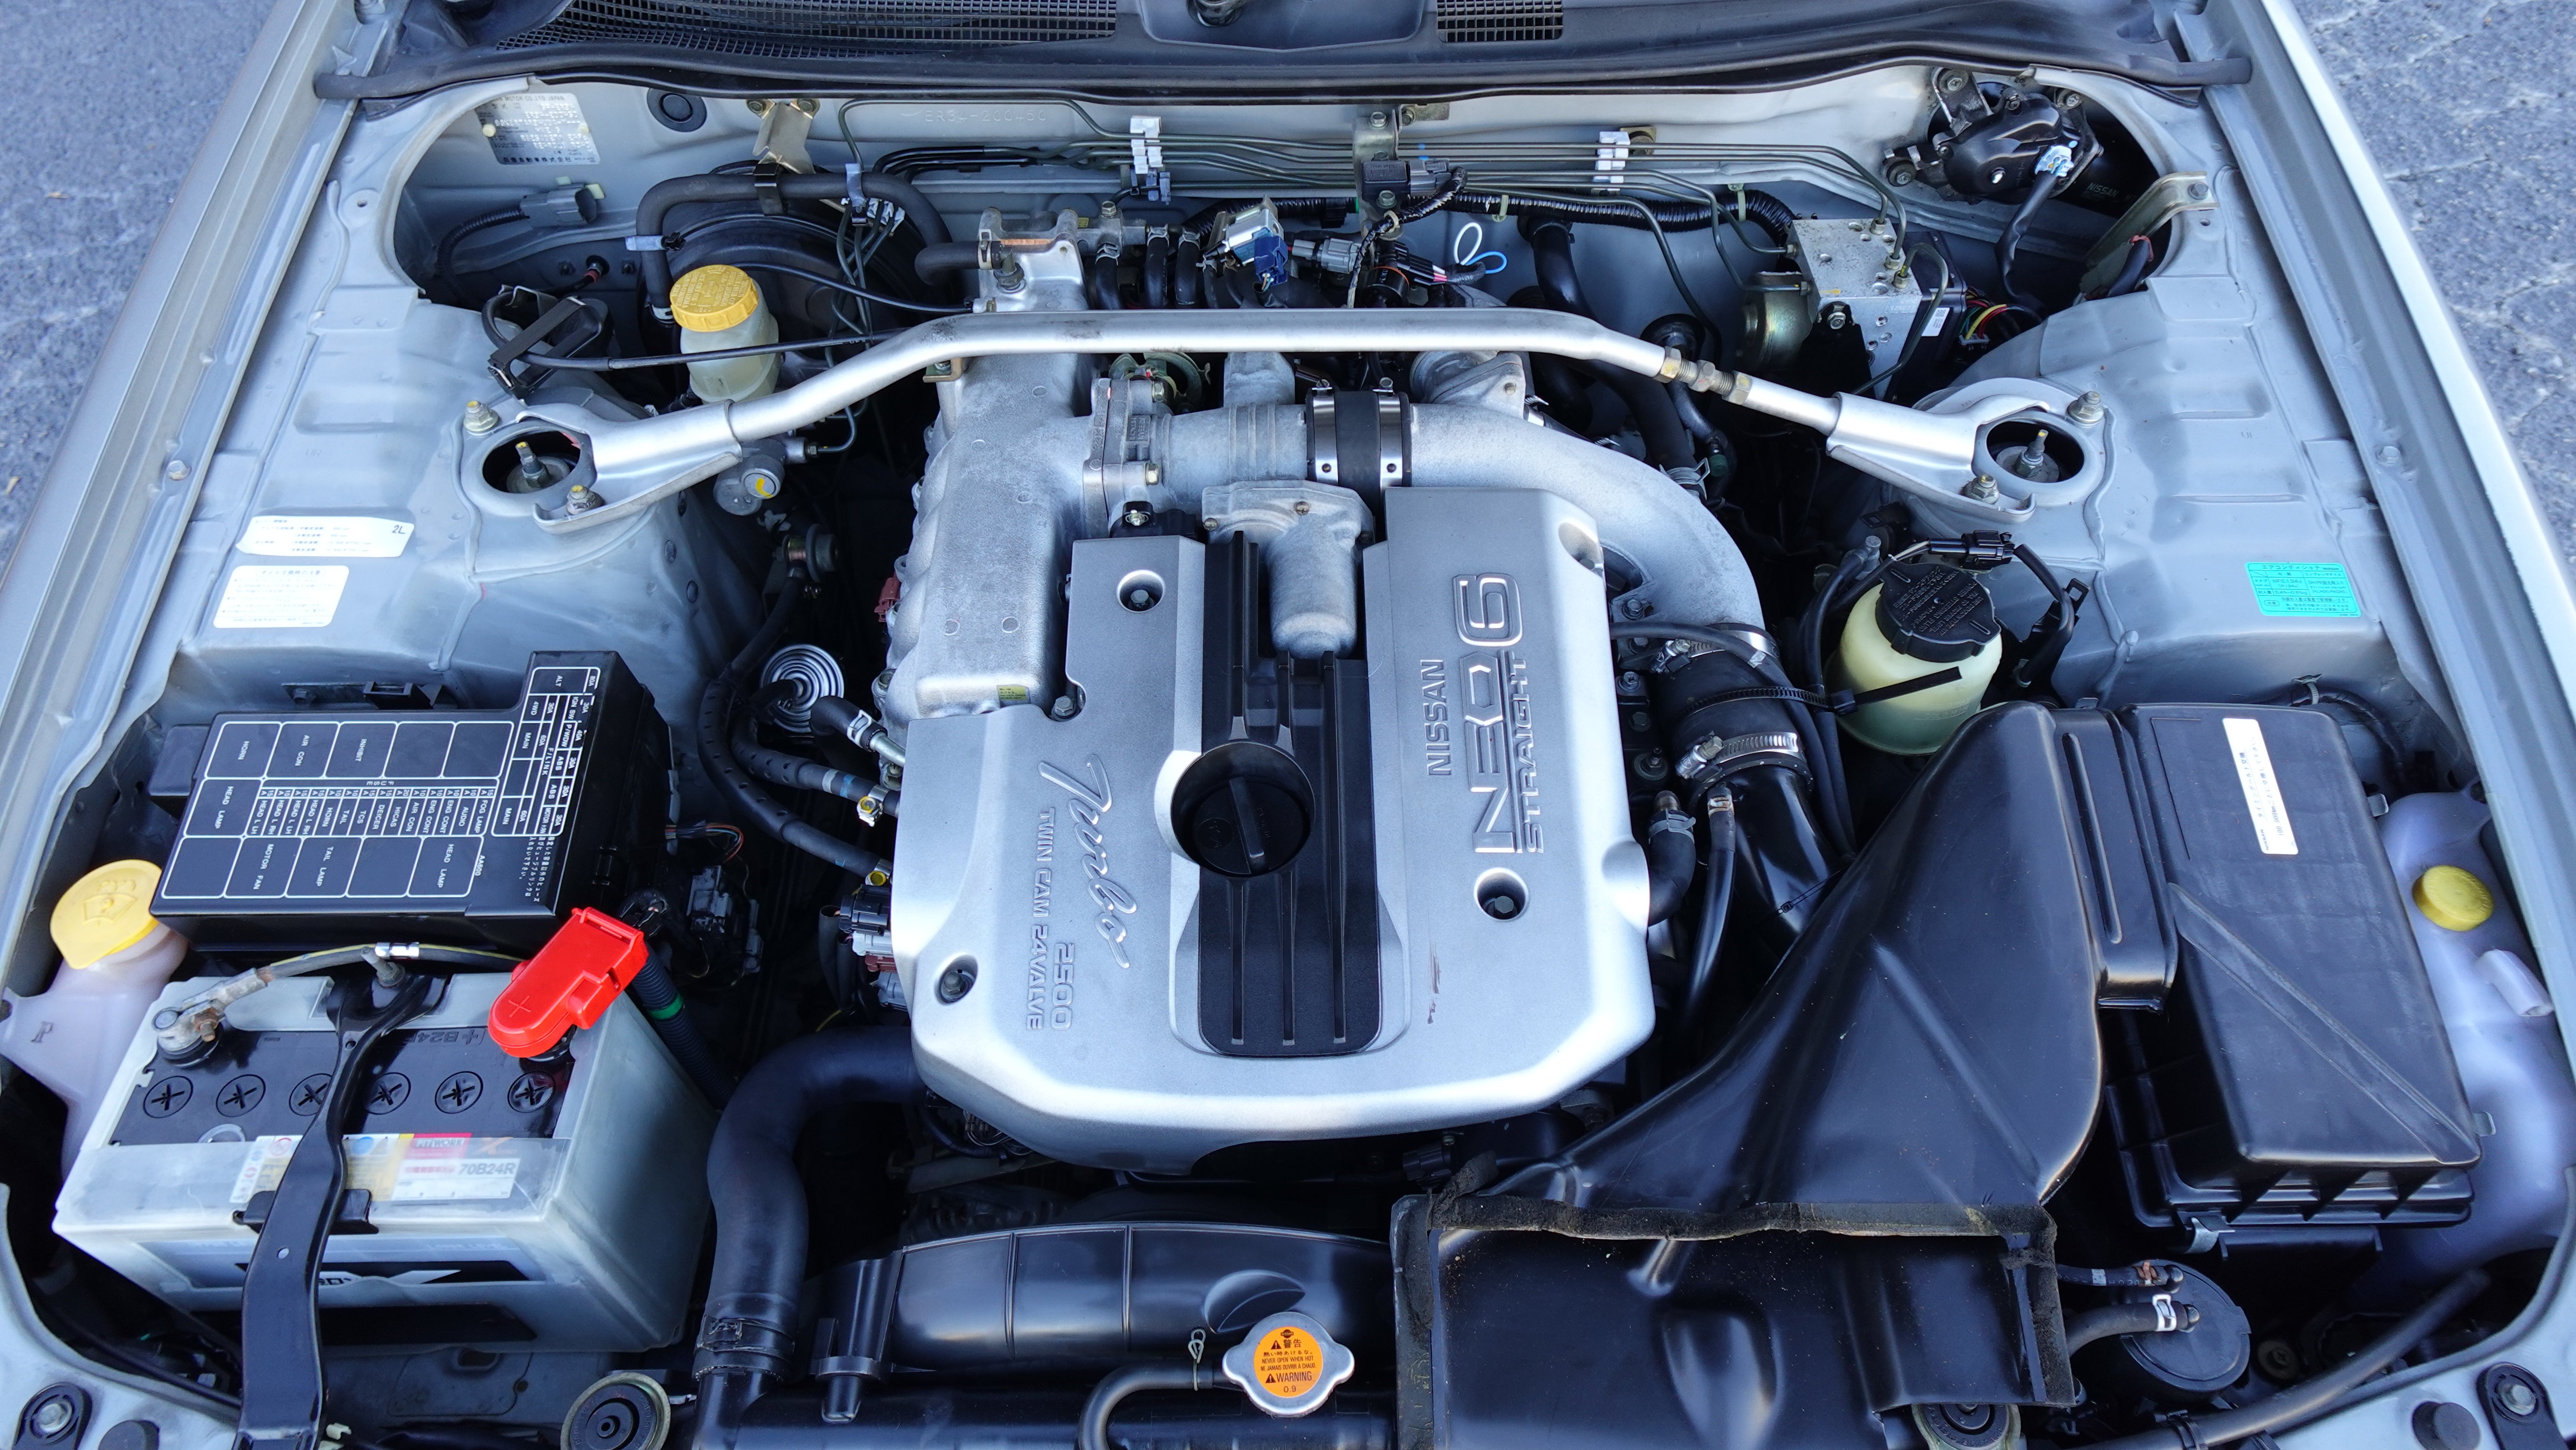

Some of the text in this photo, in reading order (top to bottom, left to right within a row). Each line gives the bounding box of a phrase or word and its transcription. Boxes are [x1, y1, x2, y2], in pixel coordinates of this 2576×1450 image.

[2087, 182, 2119, 198] NISSAN
[1452, 572, 1523, 647] 6
[555, 675, 563, 687] ALT
[531, 701, 539, 716] 4WD
[547, 702, 555, 714] 30A
[568, 710, 576, 720] SW
[582, 702, 590, 714] 30A
[1419, 659, 1452, 776] NISSAN
[522, 732, 531, 749] MAIN
[539, 734, 547, 747] 60A
[238, 741, 250, 760] HORN
[295, 735, 310, 766] AIR CON
[355, 738, 367, 762] INHIBIT
[1458, 651, 1516, 854] NEO
[1507, 650, 1545, 854] STRAIGHT
[555, 756, 564, 771] ABS
[568, 757, 576, 769] 30A
[548, 784, 557, 799] ABS
[562, 785, 570, 798] 30A
[215, 786, 234, 829] HEAD LAMP
[257, 800, 267, 818] HEAD
[274, 800, 284, 817] HEAD
[291, 800, 302, 818] HEAD
[308, 800, 319, 817] HEAD
[459, 806, 469, 827] AUDIO
[475, 800, 488, 833] FOG LAMP
[502, 808, 512, 825] MAIN
[519, 810, 527, 822] 60A
[322, 807, 333, 827] HORN
[339, 810, 350, 825] TAIL
[357, 810, 366, 824] TCS
[372, 805, 385, 830] DEICER
[390, 807, 402, 828] HICAS
[406, 802, 419, 832] AIR CON
[423, 800, 437, 834] ENG CONT
[439, 800, 454, 834] ENG CONT
[555, 814, 563, 826] 30A
[2260, 829, 2269, 851] NISSAN
[253, 844, 274, 890] MOTOR FAN
[315, 846, 334, 887] TAIL LAMP
[437, 844, 455, 888] HEAD LAMP
[475, 854, 486, 877] AA600
[1037, 753, 1137, 968] Turbo
[1026, 806, 1056, 1031] TWIN CAM 24VALVE
[1050, 942, 1075, 1031] 2500
[459, 1162, 516, 1176] 70B24R
[1283, 1338, 1302, 1348] 警告
[1276, 1370, 1312, 1383] WARNING
[1283, 1385, 1296, 1393] 0.9
